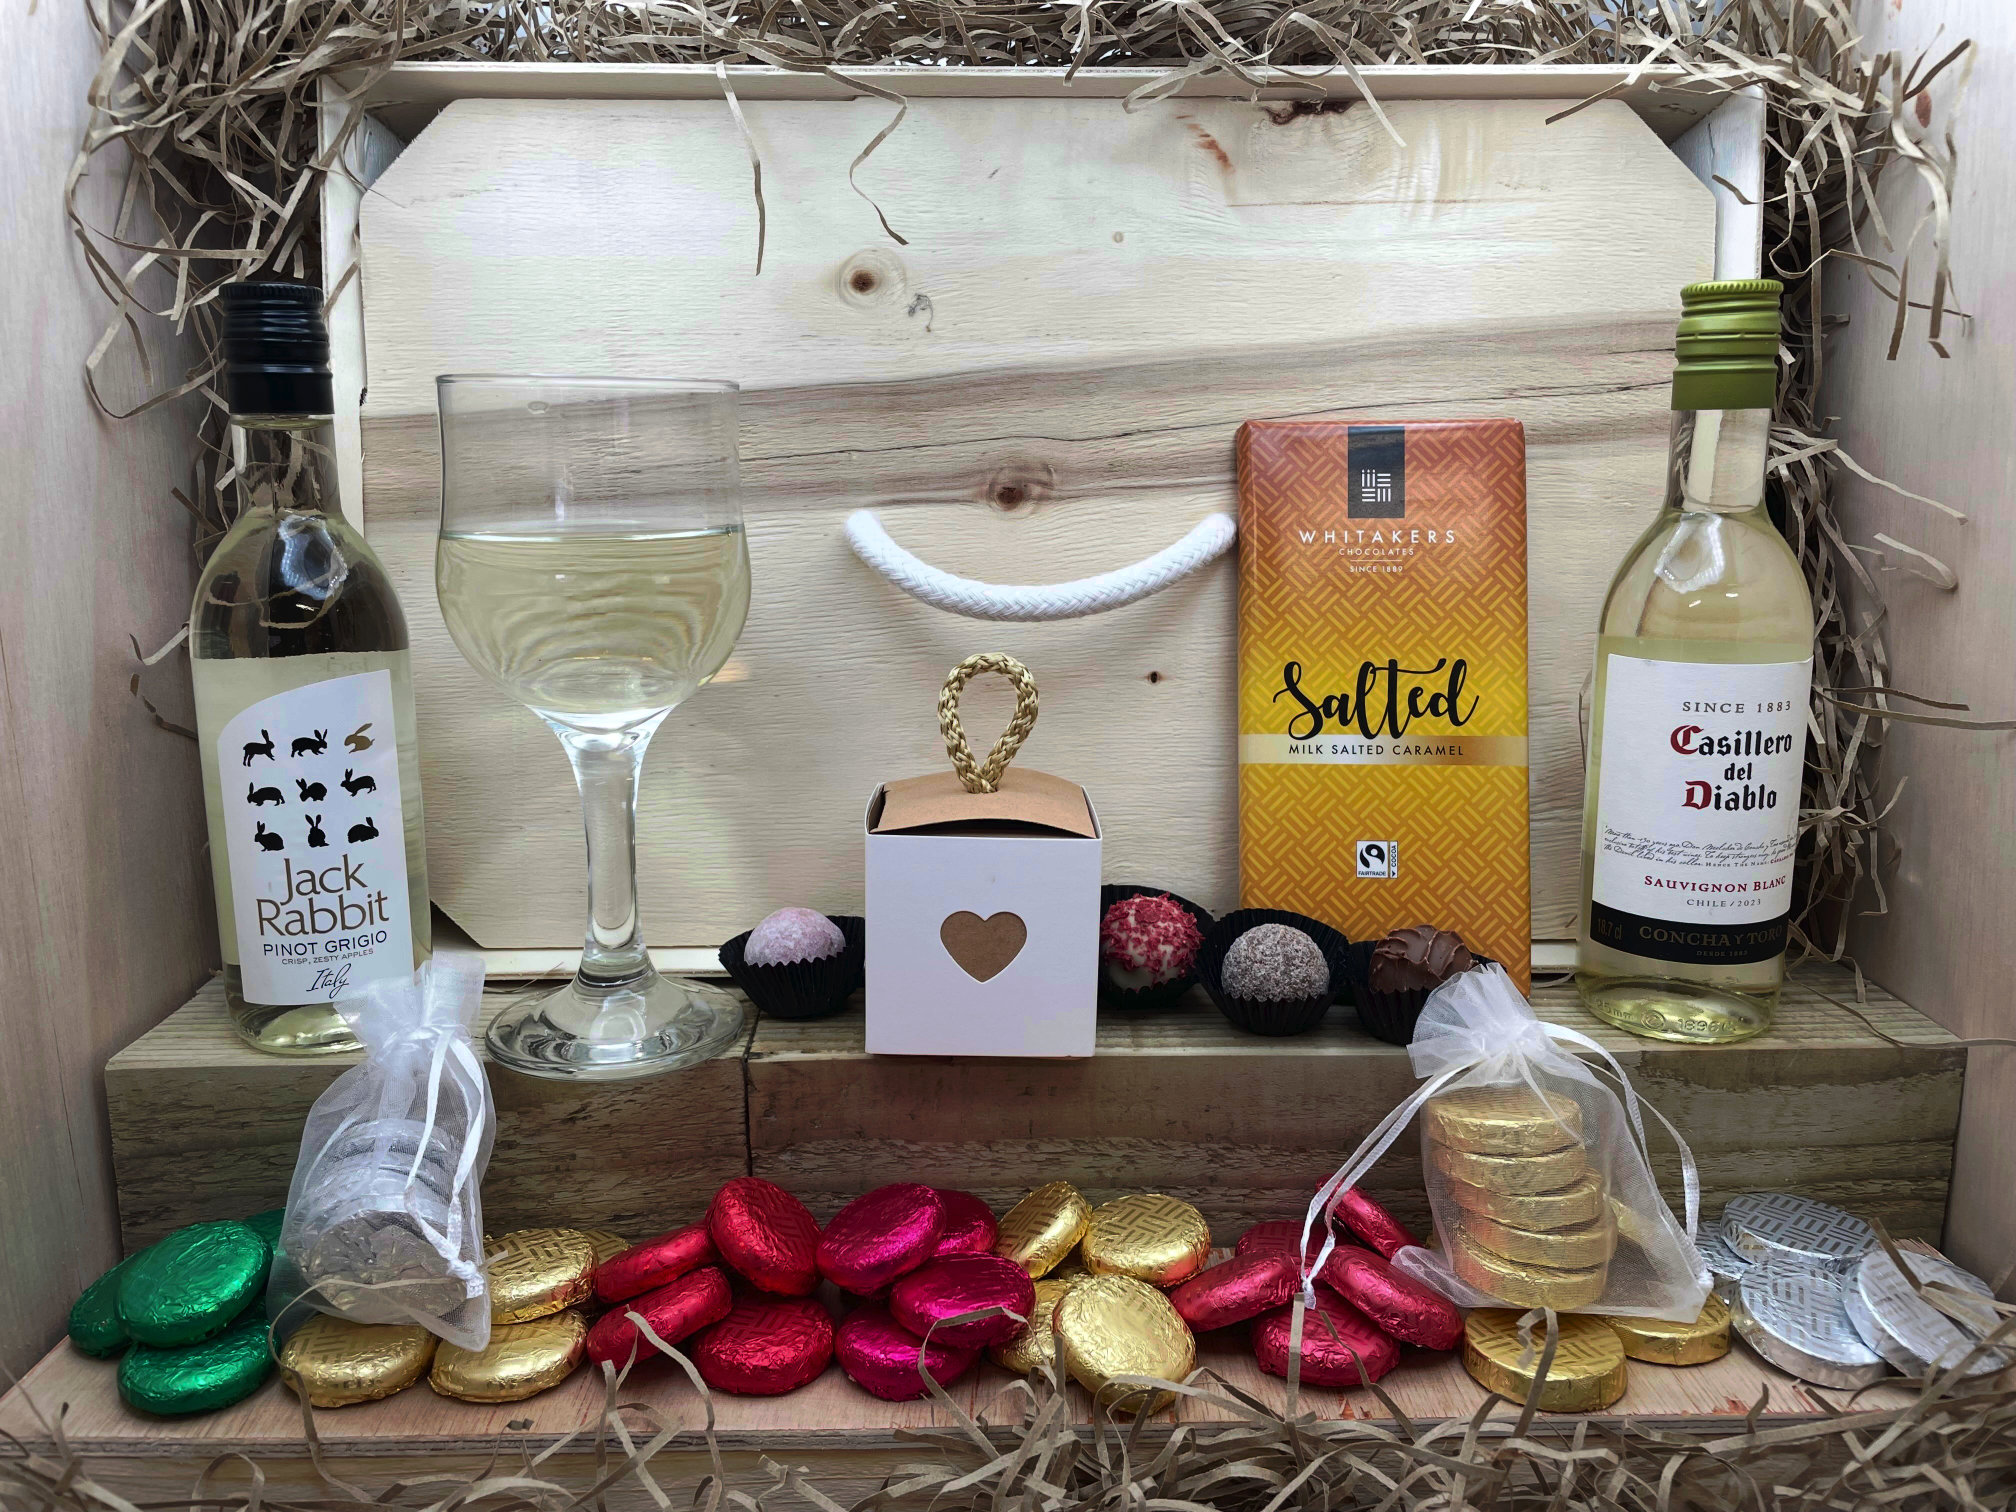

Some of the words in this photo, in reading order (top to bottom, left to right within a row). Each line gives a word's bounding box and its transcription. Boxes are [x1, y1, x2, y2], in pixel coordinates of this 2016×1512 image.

[1299, 530, 1455, 544] WHITAKERS
[1339, 548, 1414, 556] CHOCOLATES
[1273, 658, 1480, 740] Salted
[1682, 701, 1745, 713] SINCE
[1757, 700, 1791, 713] 1883
[1289, 744, 1324, 755] MILK
[1331, 744, 1385, 755] SALTED
[1392, 745, 1464, 756] CARAMEL
[1670, 725, 1793, 757] Casillero
[1724, 762, 1753, 781] del
[1681, 780, 1777, 811] Diablo
[280, 853, 369, 906] Jack
[1644, 875, 1748, 893] SAUVIGNON
[1753, 875, 1786, 892] BLANC
[256, 890, 390, 936] Rabbit
[1597, 917, 1613, 937] 18.7
[1614, 924, 1622, 941] cl
[1639, 925, 1732, 947] CONCHA
[1735, 934, 1744, 945] Y
[1746, 924, 1782, 945] TORO
[263, 942, 318, 957] PINOT
[325, 930, 387, 953] GRIGIO
[281, 958, 312, 966] CRISP,
[313, 955, 339, 964] ZESTY
[341, 948, 374, 961] APPLES
[306, 963, 352, 999] Italy
